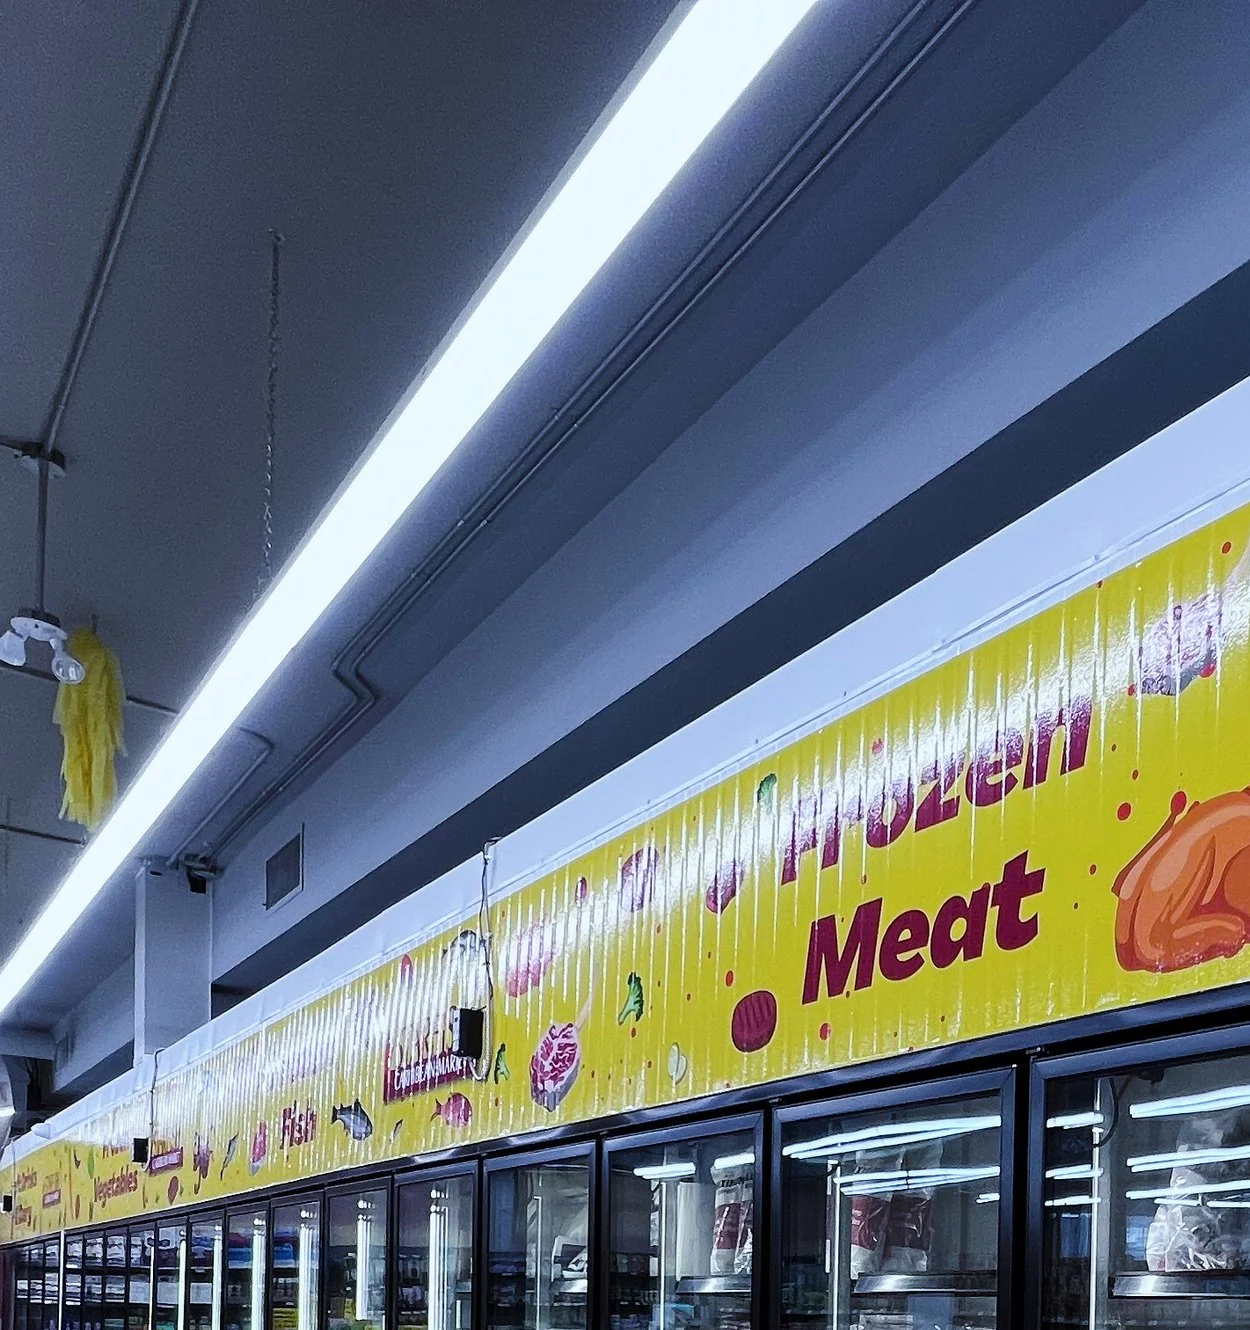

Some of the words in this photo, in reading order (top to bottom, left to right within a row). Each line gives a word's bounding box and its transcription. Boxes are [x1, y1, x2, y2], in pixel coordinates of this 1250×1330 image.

[780, 696, 1093, 886] Frozen
[801, 850, 1046, 1006] Meat
[280, 1099, 318, 1150] Fish
